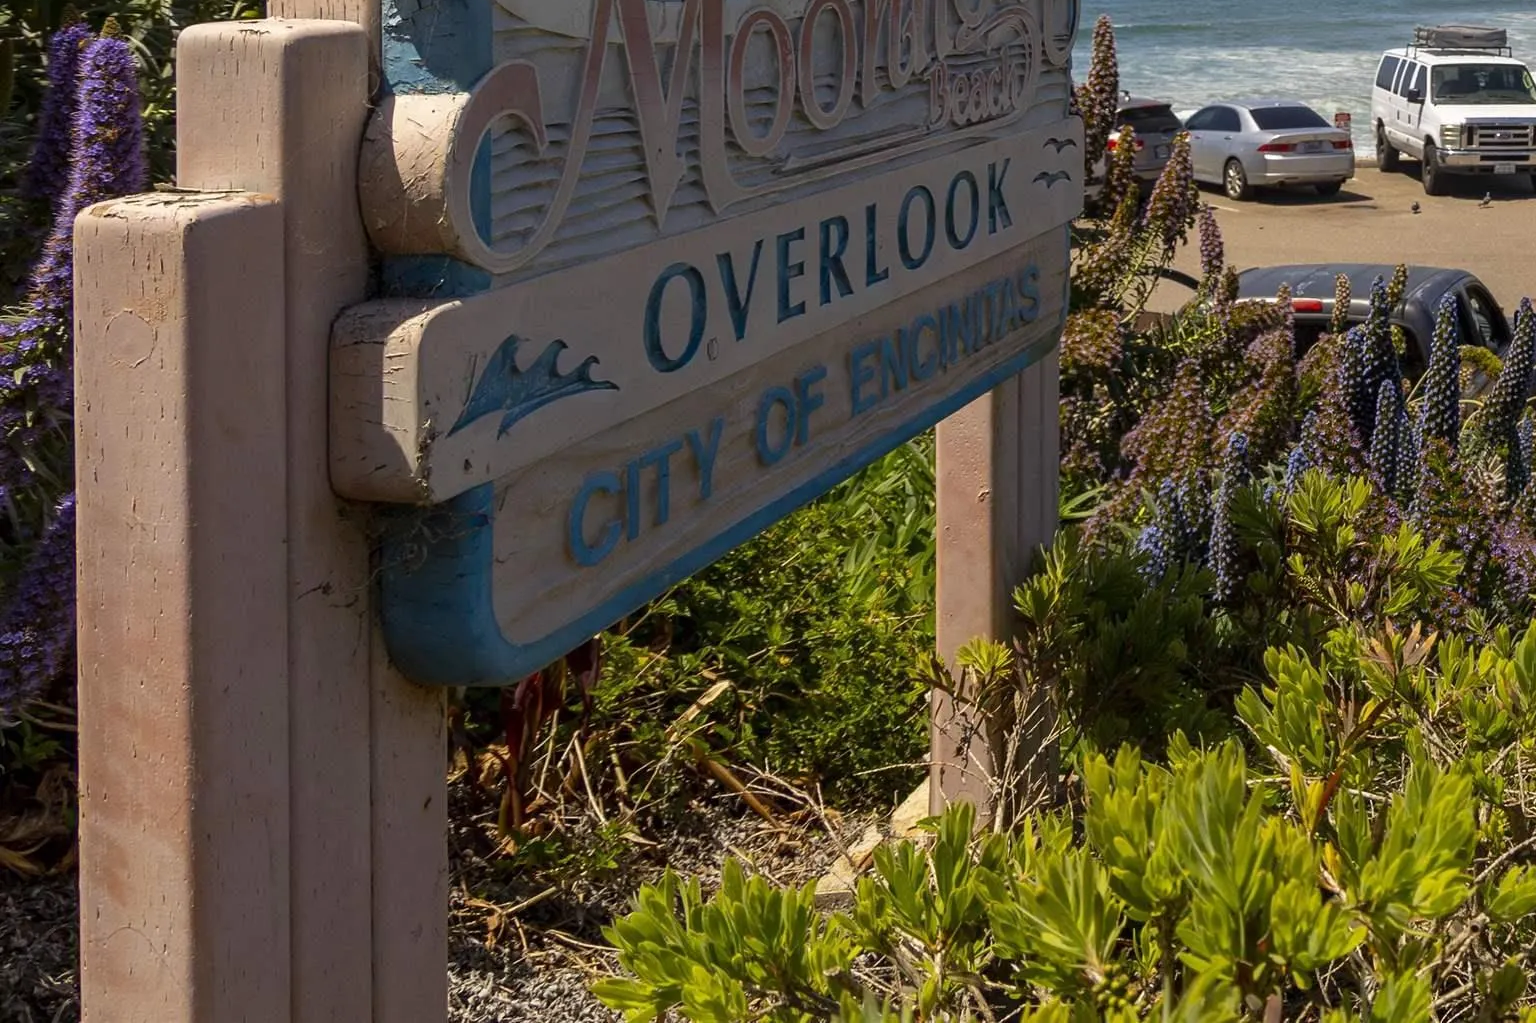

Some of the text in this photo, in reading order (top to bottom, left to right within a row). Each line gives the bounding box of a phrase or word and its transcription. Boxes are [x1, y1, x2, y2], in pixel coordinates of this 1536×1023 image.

[923, 46, 1024, 127] Beach
[643, 157, 1012, 374] OVERLOOK
[567, 263, 1041, 568] CITY OF ENCINITAS
